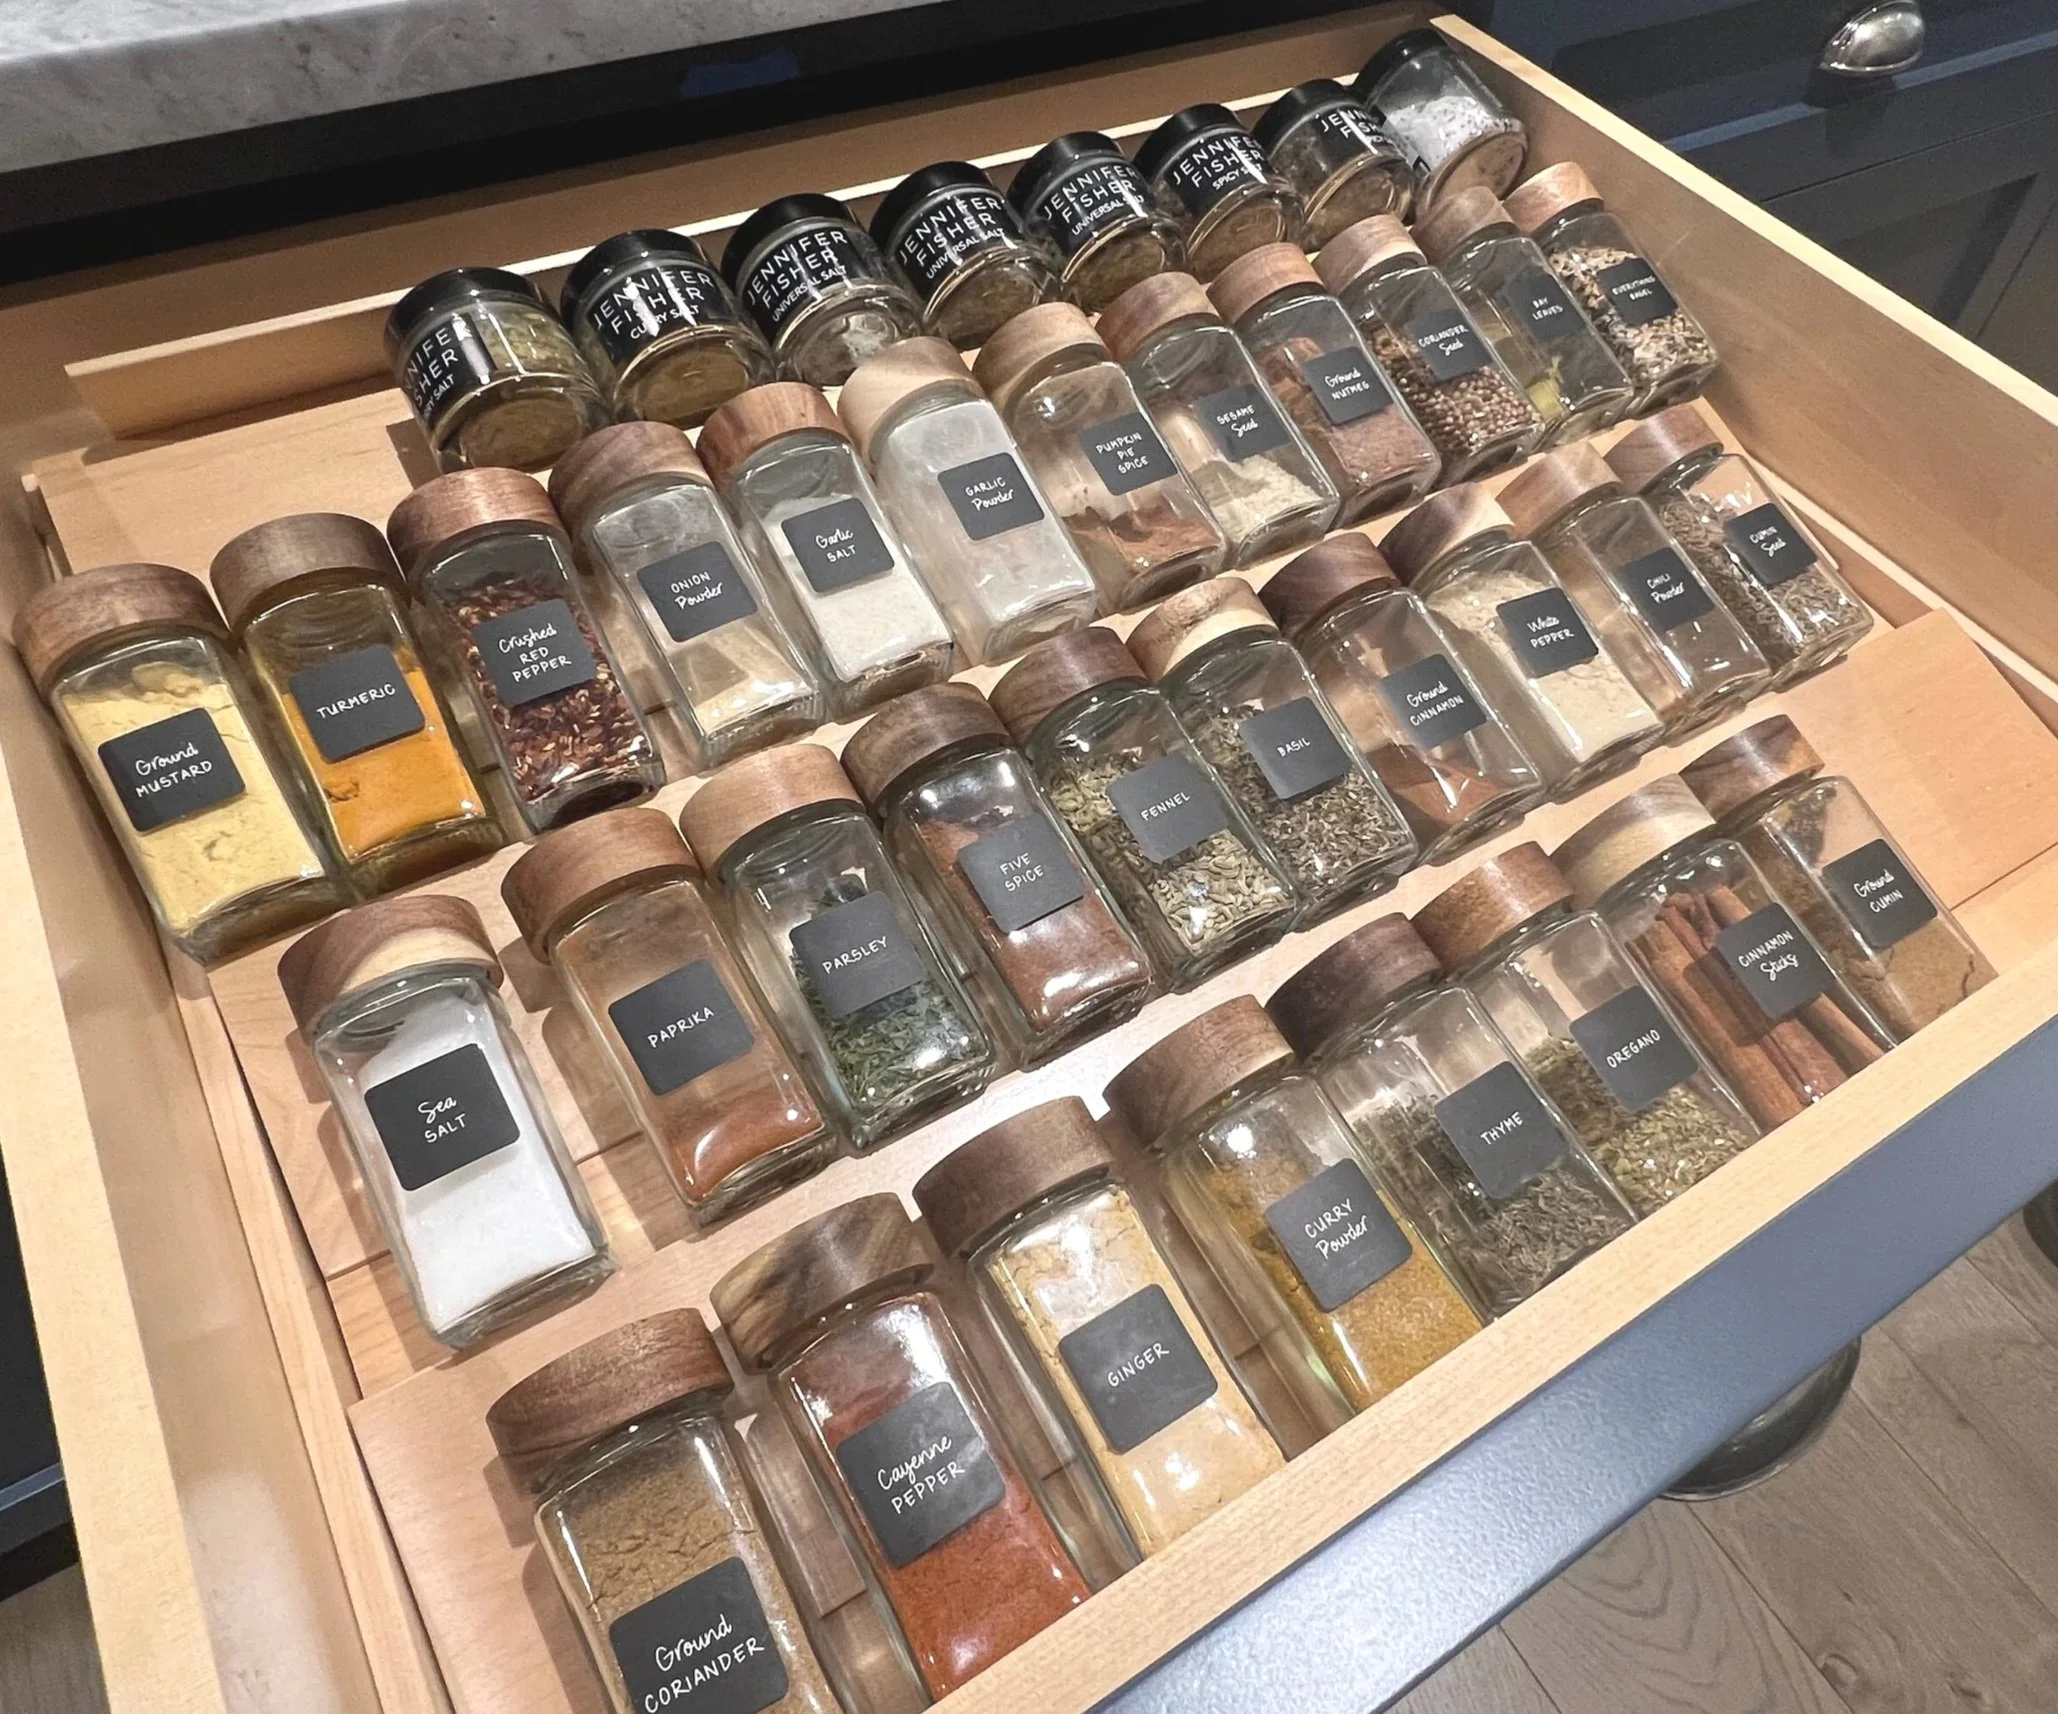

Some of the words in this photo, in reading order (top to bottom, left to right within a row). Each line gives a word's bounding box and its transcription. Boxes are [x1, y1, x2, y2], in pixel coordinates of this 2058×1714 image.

[1044, 165, 1140, 221] JENNIFER
[1212, 168, 1240, 190] SPICY
[1062, 179, 1137, 224] FISHER
[900, 197, 1002, 266] JENNIFER
[1071, 199, 1125, 236] UNIVERSAL
[916, 212, 997, 268] FISHER
[747, 230, 848, 306] JENNIFER
[762, 248, 838, 310] FISHER
[772, 276, 822, 322] UNIVERSAL
[820, 265, 847, 281] SALT
[1612, 275, 1656, 295] EVERYTHING
[1629, 288, 1653, 300] BAGEL
[1532, 297, 1549, 309] BAY
[1532, 305, 1563, 320] LEAVES
[1418, 324, 1469, 347] CORIANDER
[1438, 338, 1464, 356] Seed
[433, 373, 455, 400] SALT
[1325, 367, 1361, 388] Ground
[1331, 380, 1370, 400] NUTMEG
[1216, 404, 1255, 424] SESAME
[1231, 418, 1258, 437] Seed
[1095, 432, 1142, 454] PUMPKIN
[1116, 447, 1135, 460] PIE
[1117, 456, 1149, 474] SPICE
[965, 477, 1006, 496] GARLIC
[971, 488, 1014, 511] Powder
[814, 527, 855, 550] Garlic
[1749, 526, 1778, 543] CUMIN
[1760, 537, 1787, 557] Seed
[826, 544, 857, 563] SALT
[670, 571, 711, 593] ONION
[1647, 573, 1671, 589] CHILI
[1650, 581, 1685, 604] Powder
[674, 581, 724, 611] Powder
[498, 622, 558, 654] Crushed
[1526, 616, 1560, 632] White
[1530, 629, 1575, 648] PEPPER
[512, 654, 572, 683] PEPPER
[520, 646, 549, 664] RED
[316, 683, 396, 719] TURMERIC
[1406, 680, 1448, 708] Ground
[1409, 695, 1464, 726] CINNAMON
[135, 742, 199, 776] Ground
[1277, 737, 1311, 757] BASIL
[135, 760, 213, 798] MUSTARD
[1140, 790, 1191, 822] FENNEL
[999, 852, 1032, 876] FIVE
[1004, 864, 1045, 893] SPICE
[1853, 868, 1895, 898] Ground
[1869, 889, 1904, 913] CUMIN
[822, 935, 889, 975] PARSLEY
[1738, 930, 1794, 967] CINNAMON
[1760, 953, 1799, 981] Sticks
[647, 1005, 715, 1049] PAPRIKA
[1606, 1028, 1661, 1069] OREGANO
[417, 1095, 458, 1124] Sea
[424, 1112, 468, 1144] SALT
[1480, 1110, 1524, 1146] THYME
[1304, 1197, 1354, 1239] CURRY
[1314, 1214, 1369, 1260] Powder
[1107, 1342, 1170, 1387] GINGER
[877, 1433, 953, 1491] Cayenne
[890, 1459, 966, 1515] PEPPER
[655, 1612, 733, 1673] Ground
[644, 1636, 766, 1714] CORIANDER
